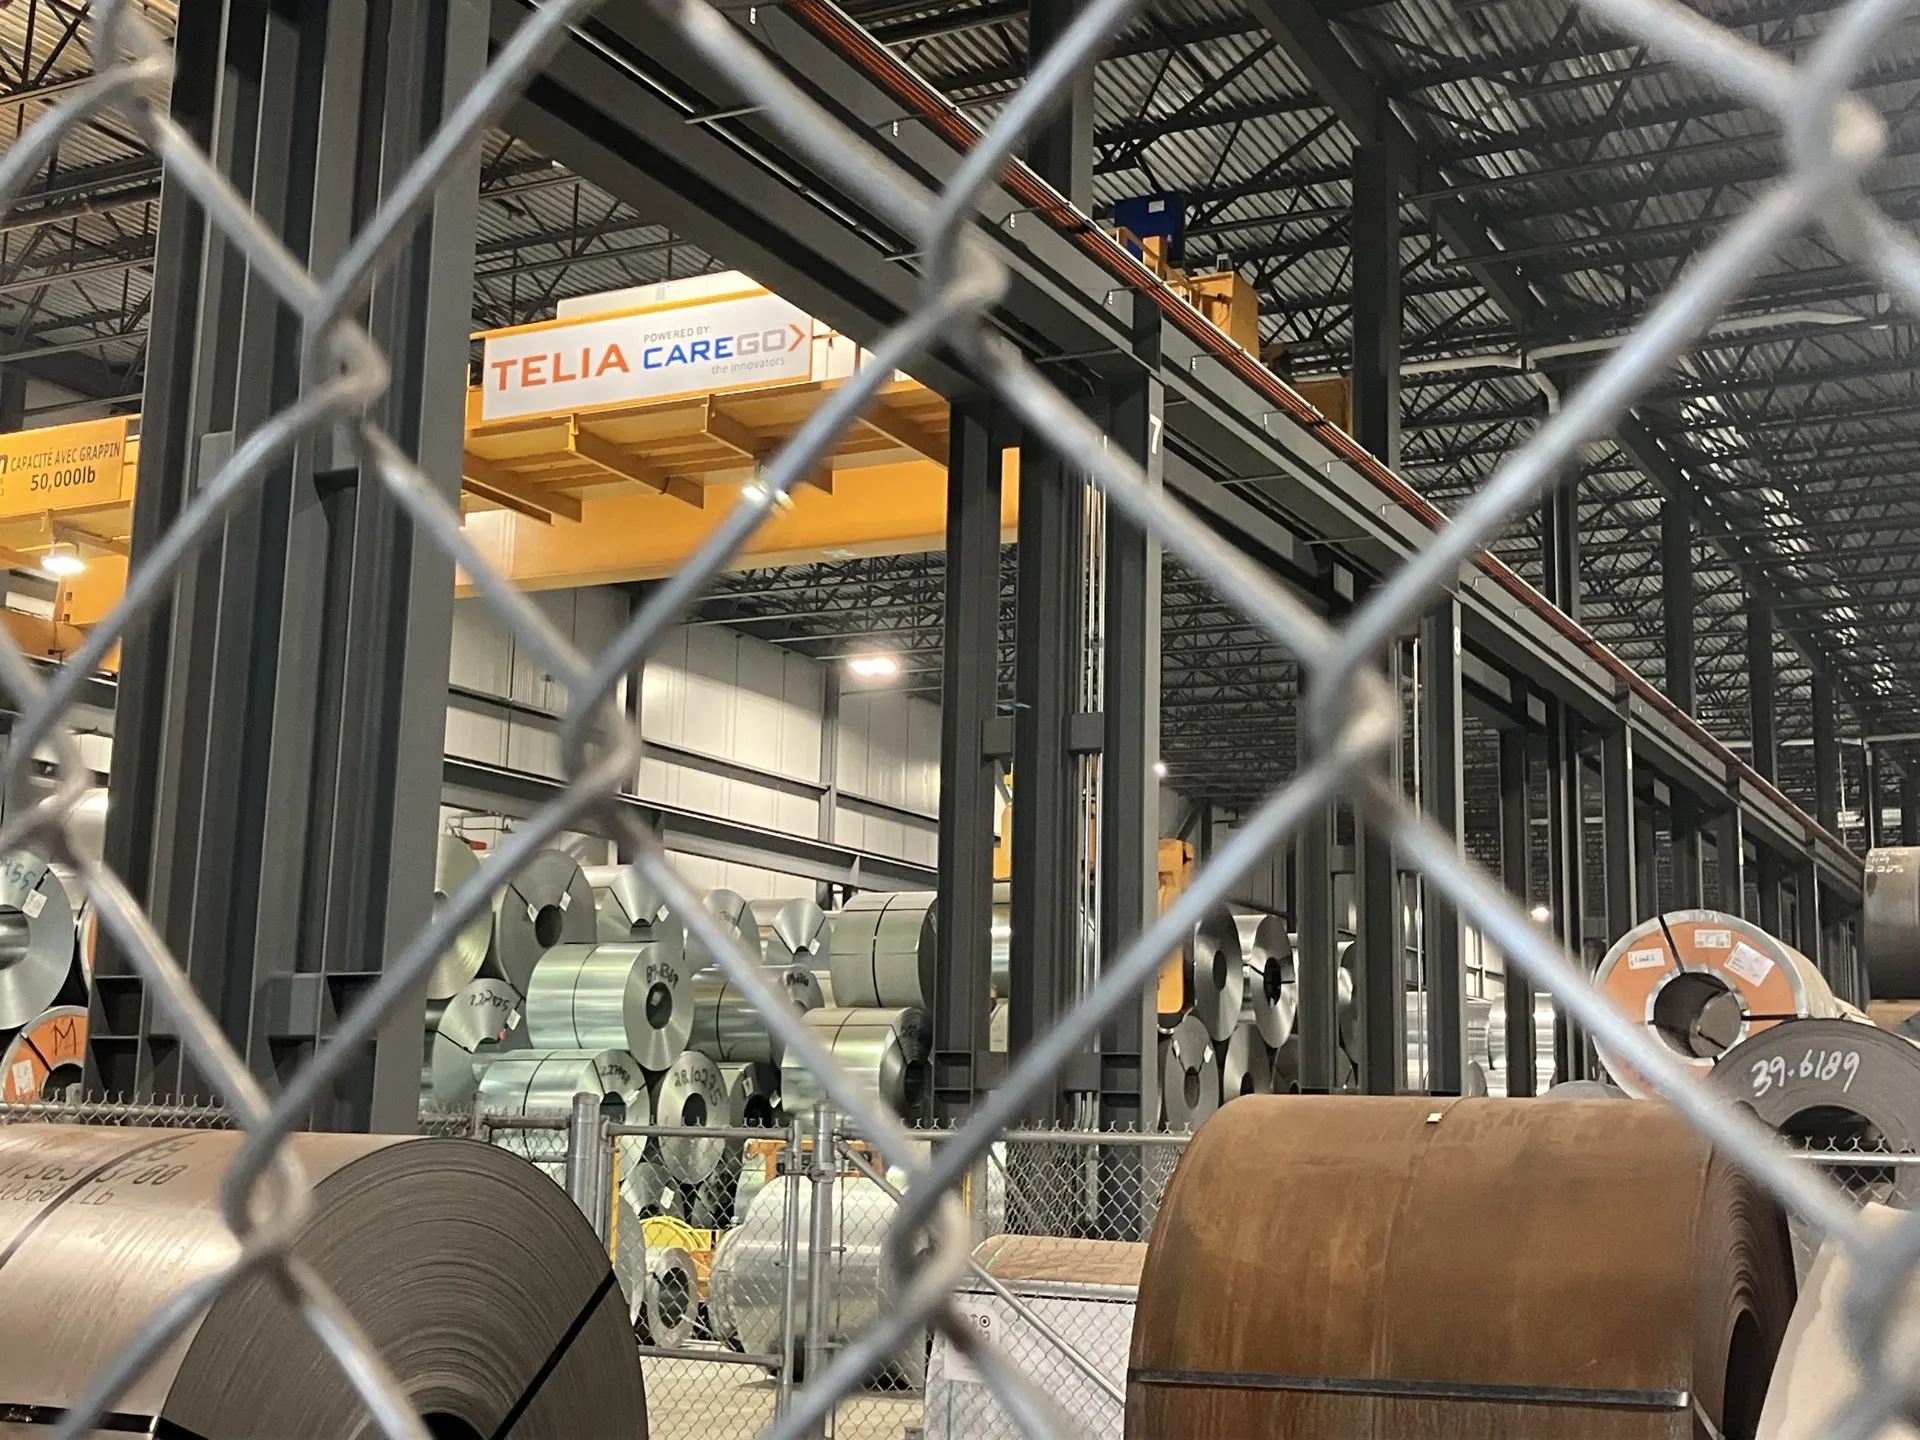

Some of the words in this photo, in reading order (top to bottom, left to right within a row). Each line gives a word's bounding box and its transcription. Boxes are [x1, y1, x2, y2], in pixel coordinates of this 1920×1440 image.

[644, 327, 694, 343] POWERED
[697, 324, 712, 336] BY:
[644, 329, 786, 369] CAREGO
[491, 343, 630, 391] TELIA
[712, 363, 729, 376] the
[731, 356, 785, 373] innovators
[10, 447, 53, 472] CAPACITÉ
[54, 448, 78, 466] AVEC
[80, 441, 121, 462] GRAPPIN
[30, 465, 96, 493] 50,000lb
[53, 1017, 77, 1057] M
[1751, 1048, 1860, 1098] 39.6189
